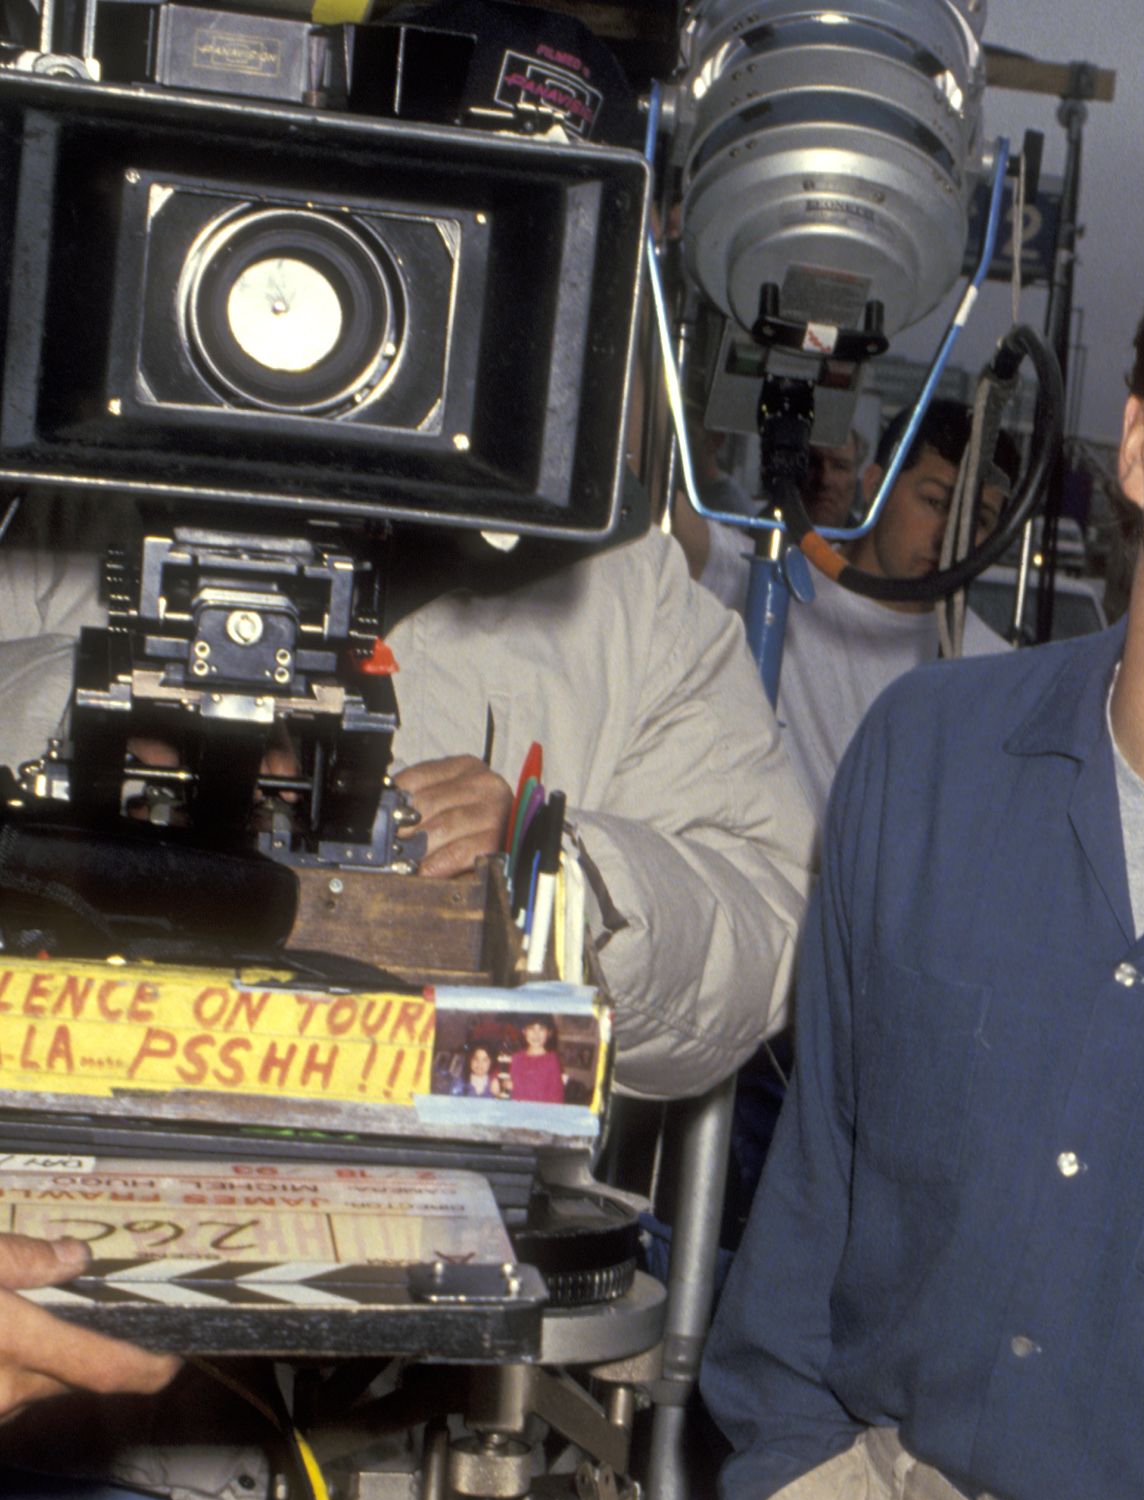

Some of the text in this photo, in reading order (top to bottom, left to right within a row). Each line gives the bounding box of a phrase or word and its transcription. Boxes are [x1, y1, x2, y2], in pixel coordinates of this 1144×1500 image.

[536, 44, 582, 70] FILMED
[193, 986, 272, 1032] ON
[52, 1176, 156, 1187] HUGO
[181, 1180, 319, 1192] MICHEL
[183, 1193, 329, 1207] JAMES
